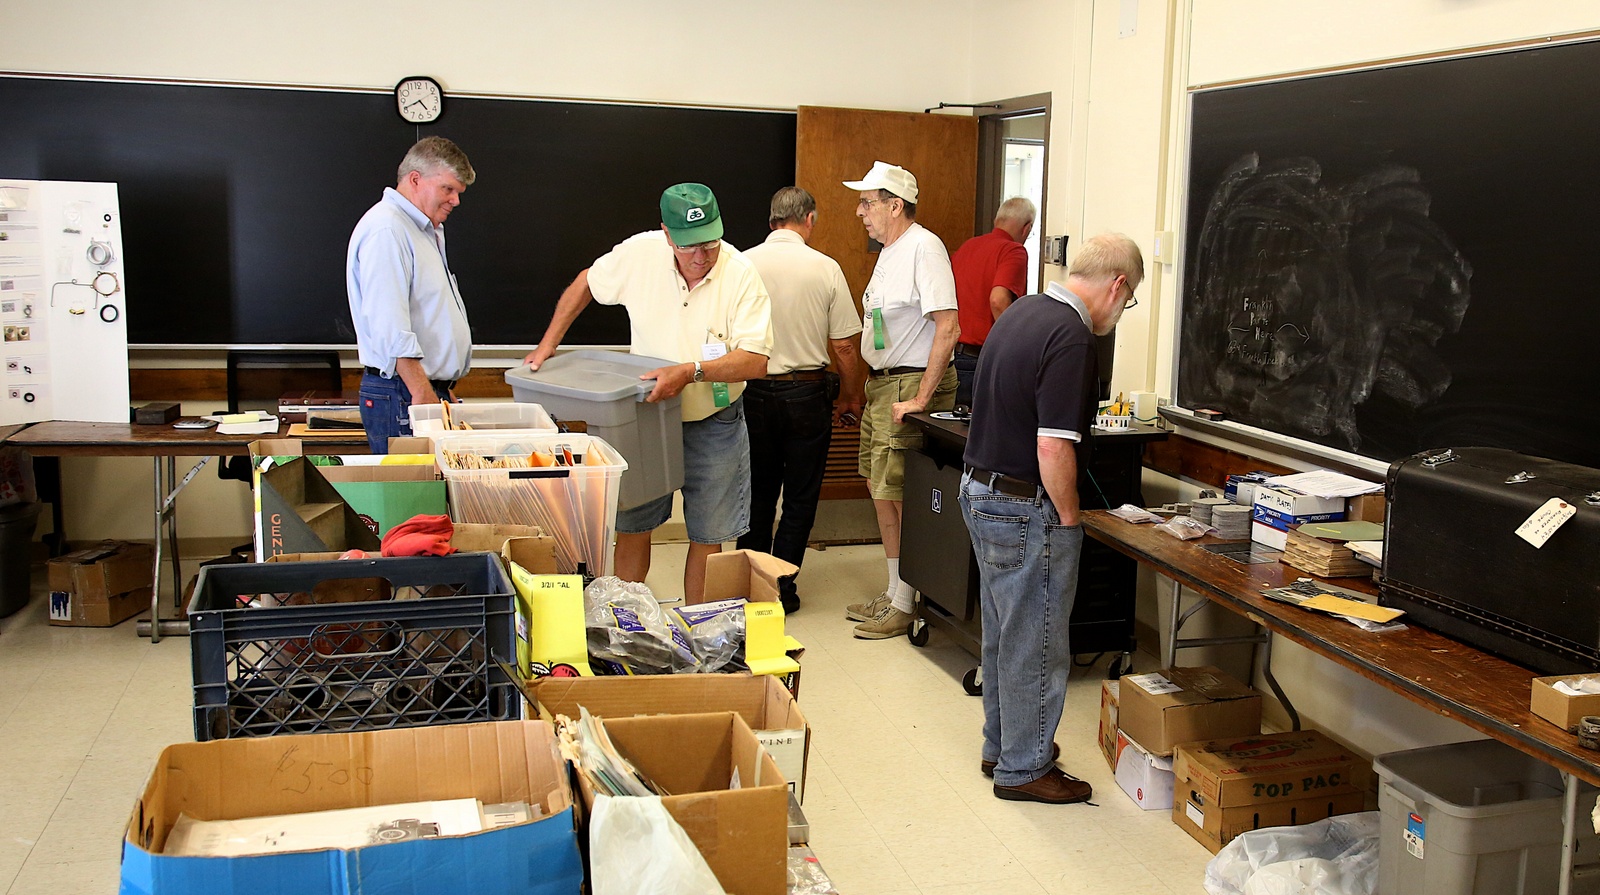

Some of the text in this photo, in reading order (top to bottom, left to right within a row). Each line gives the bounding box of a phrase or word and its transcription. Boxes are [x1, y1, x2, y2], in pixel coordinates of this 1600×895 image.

[406, 82, 414, 90] 11
[413, 81, 422, 90] 12
[400, 89, 410, 97] 10
[430, 87, 436, 95] 2
[433, 96, 439, 104] 3
[410, 111, 415, 119] 7
[418, 112, 424, 120] 6
[426, 110, 433, 119] 5
[1255, 326, 1275, 341] Here
[1266, 508, 1282, 519] PRIORITY
[1252, 772, 1341, 798] TOP PAC
